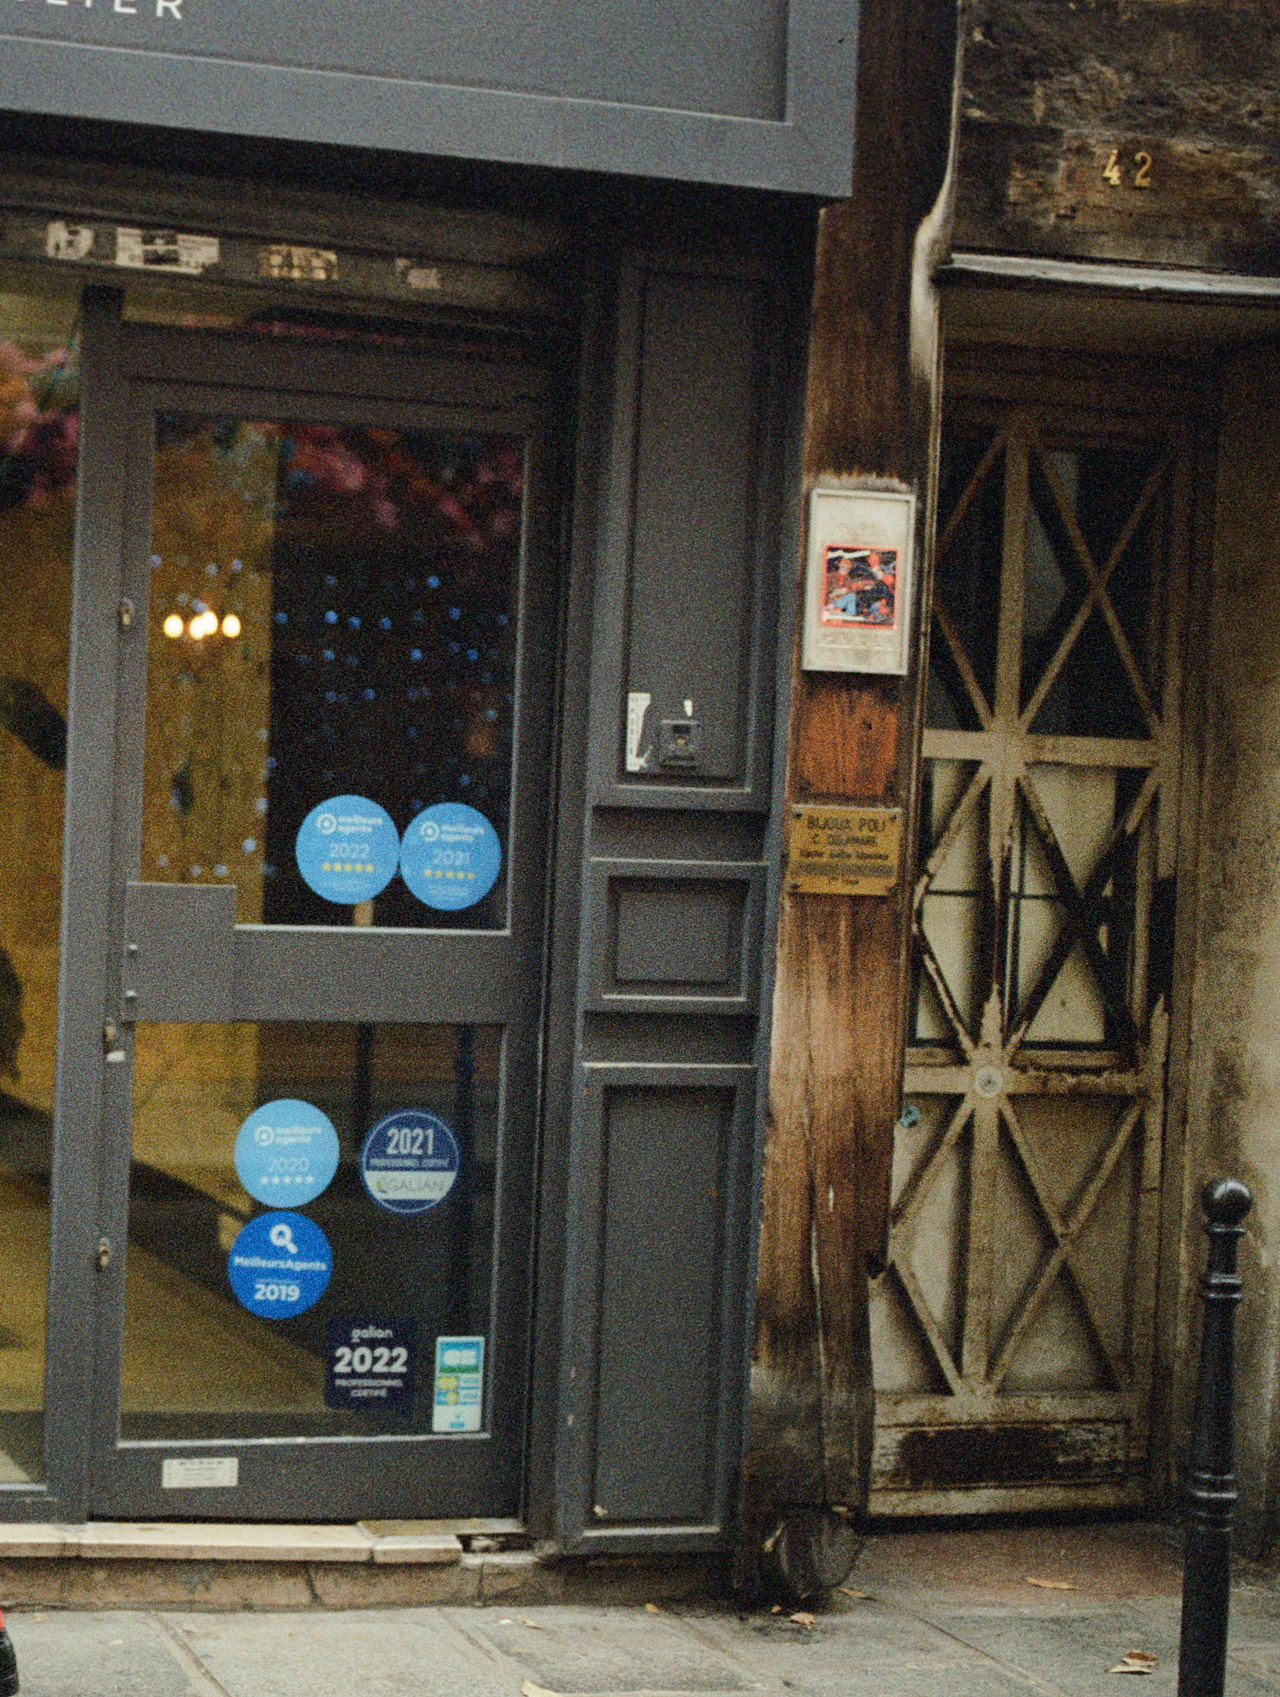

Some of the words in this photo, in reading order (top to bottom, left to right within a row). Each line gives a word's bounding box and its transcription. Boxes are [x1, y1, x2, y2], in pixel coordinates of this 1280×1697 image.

[1102, 148, 1152, 187] 42
[329, 842, 371, 859] 2022
[432, 848, 472, 867] 2021
[386, 1126, 436, 1156] 2021
[268, 1156, 311, 1173] 2020
[253, 1283, 301, 1302] 2019
[333, 1346, 409, 1374] 2022
